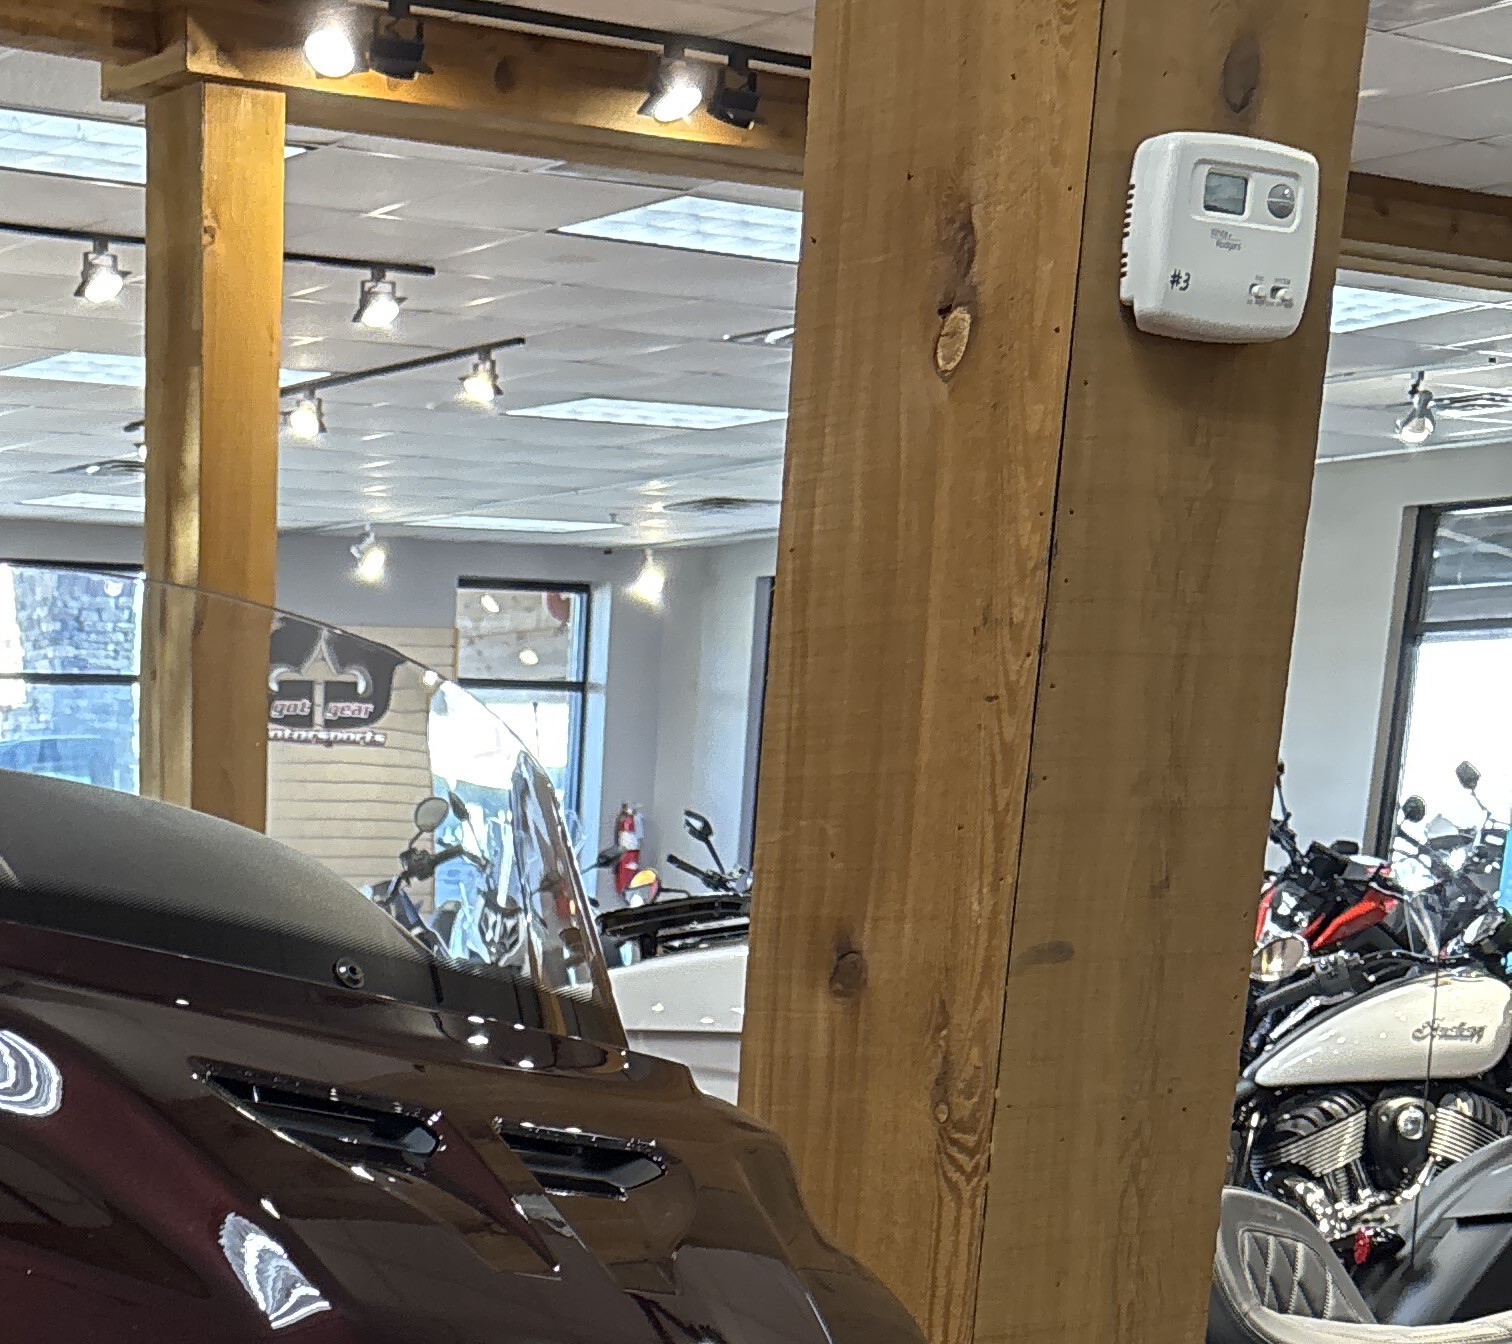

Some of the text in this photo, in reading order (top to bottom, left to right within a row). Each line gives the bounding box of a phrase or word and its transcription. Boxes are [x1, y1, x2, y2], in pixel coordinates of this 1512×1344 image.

[1170, 269, 1191, 292] #3
[270, 698, 375, 720] got gear
